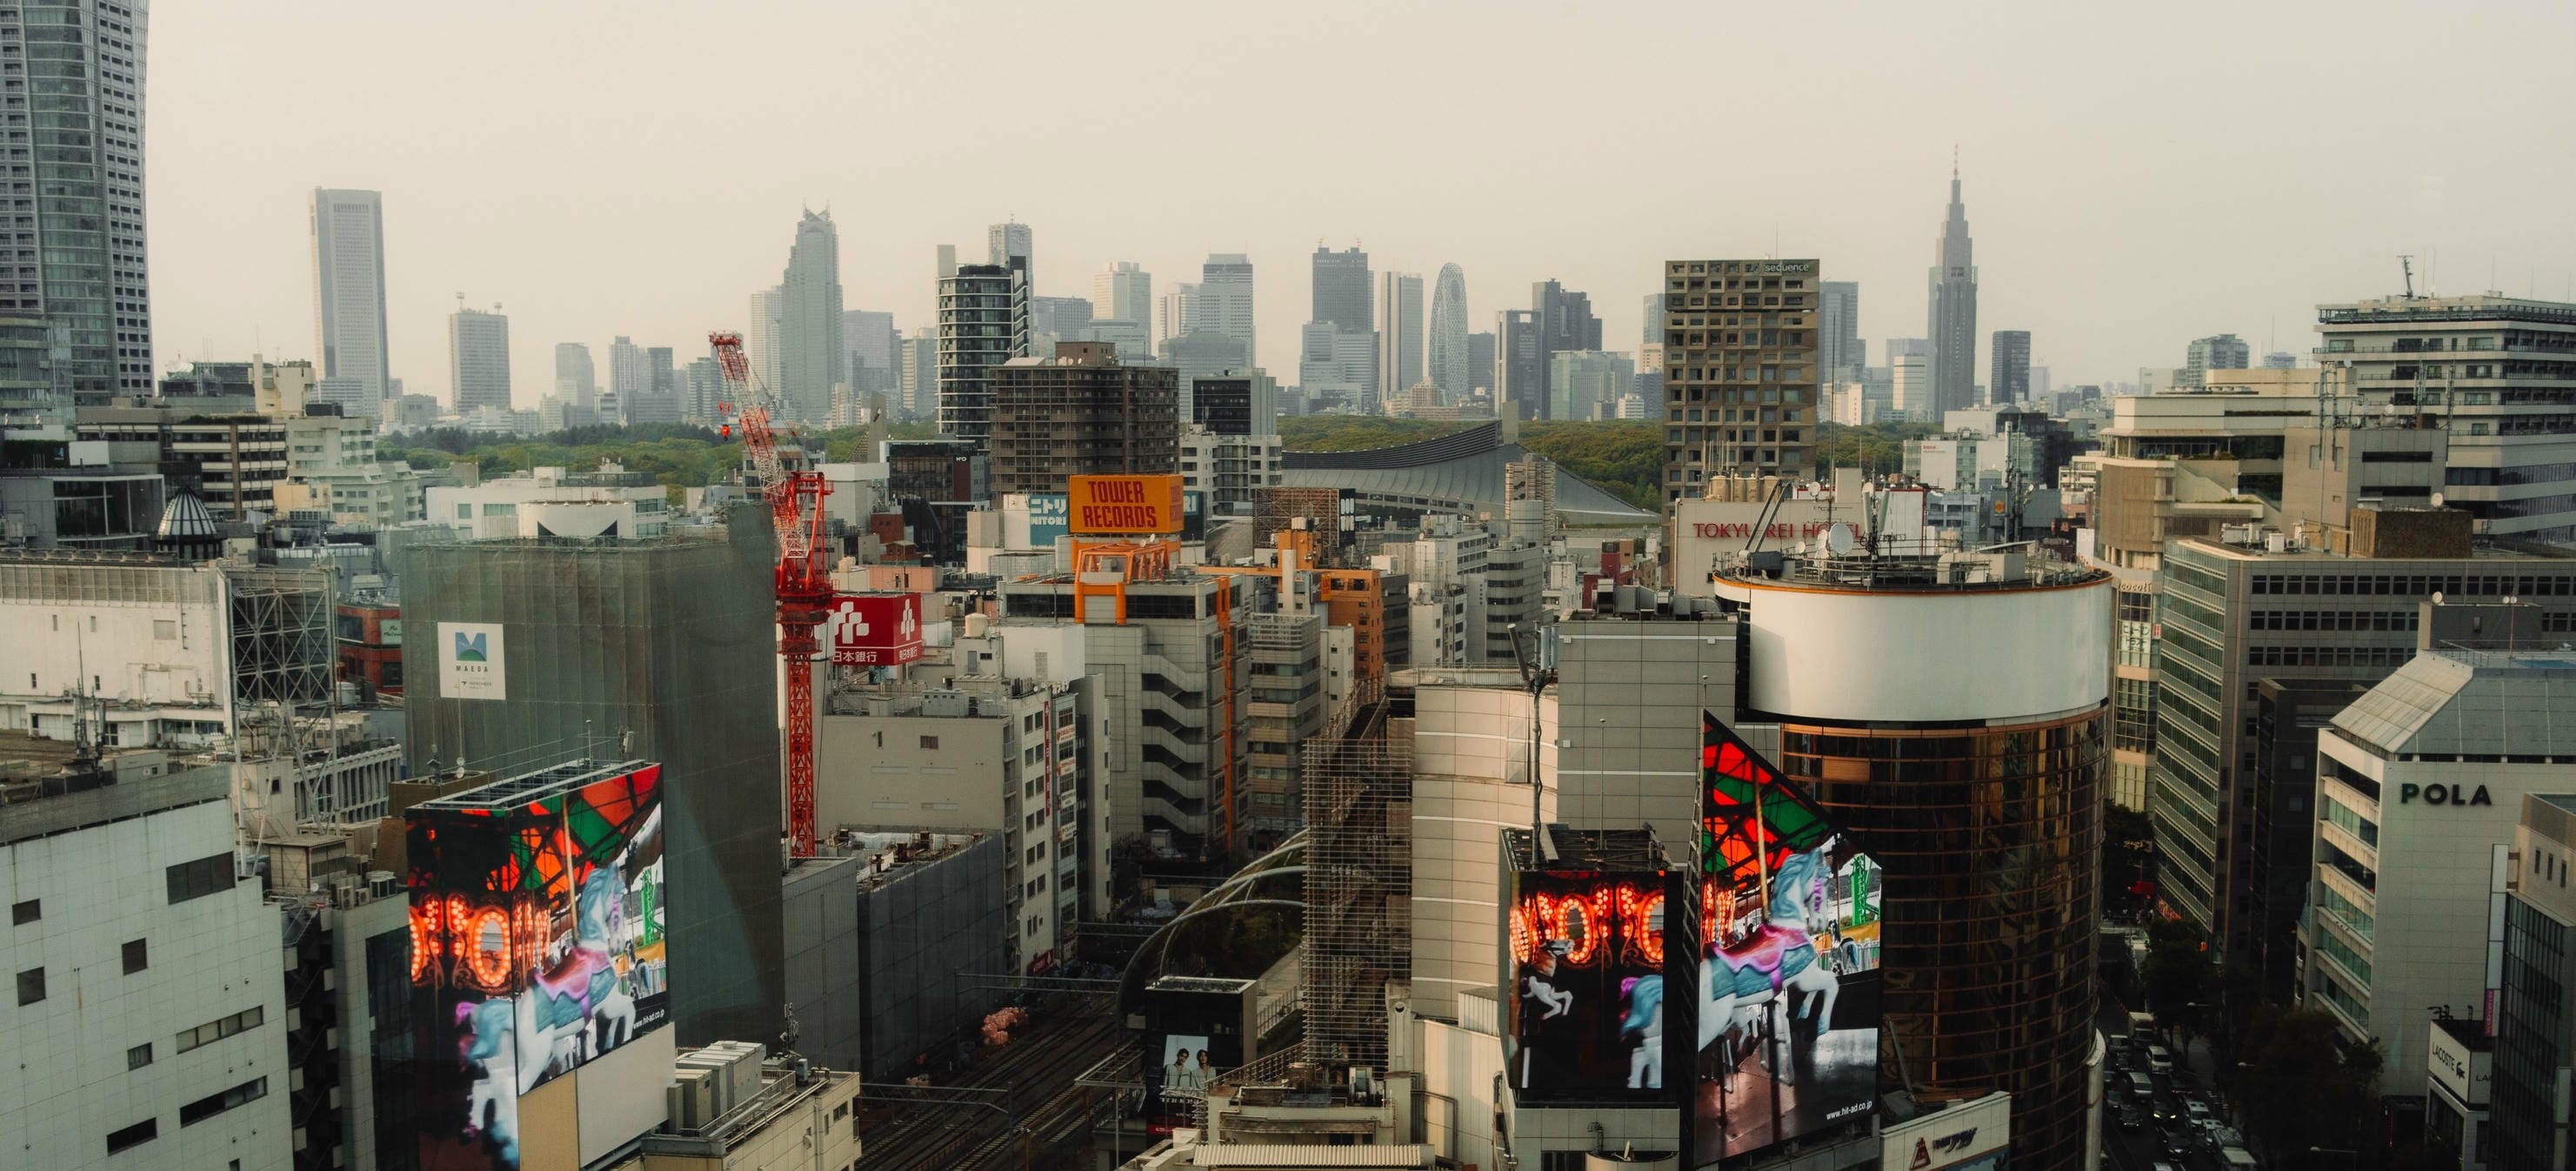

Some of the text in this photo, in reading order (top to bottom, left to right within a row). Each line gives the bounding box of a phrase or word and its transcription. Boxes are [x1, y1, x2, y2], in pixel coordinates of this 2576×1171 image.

[1765, 264, 1810, 273] sequence
[1088, 480, 1145, 504] TOWER
[1031, 498, 1066, 515] ニトリ
[1082, 505, 1158, 528] RECORDS
[2400, 783, 2492, 806] POLA
[2432, 1041, 2455, 1072] LACOSTE
[1826, 1099, 1872, 1121] www.hit-ad.co.jp
